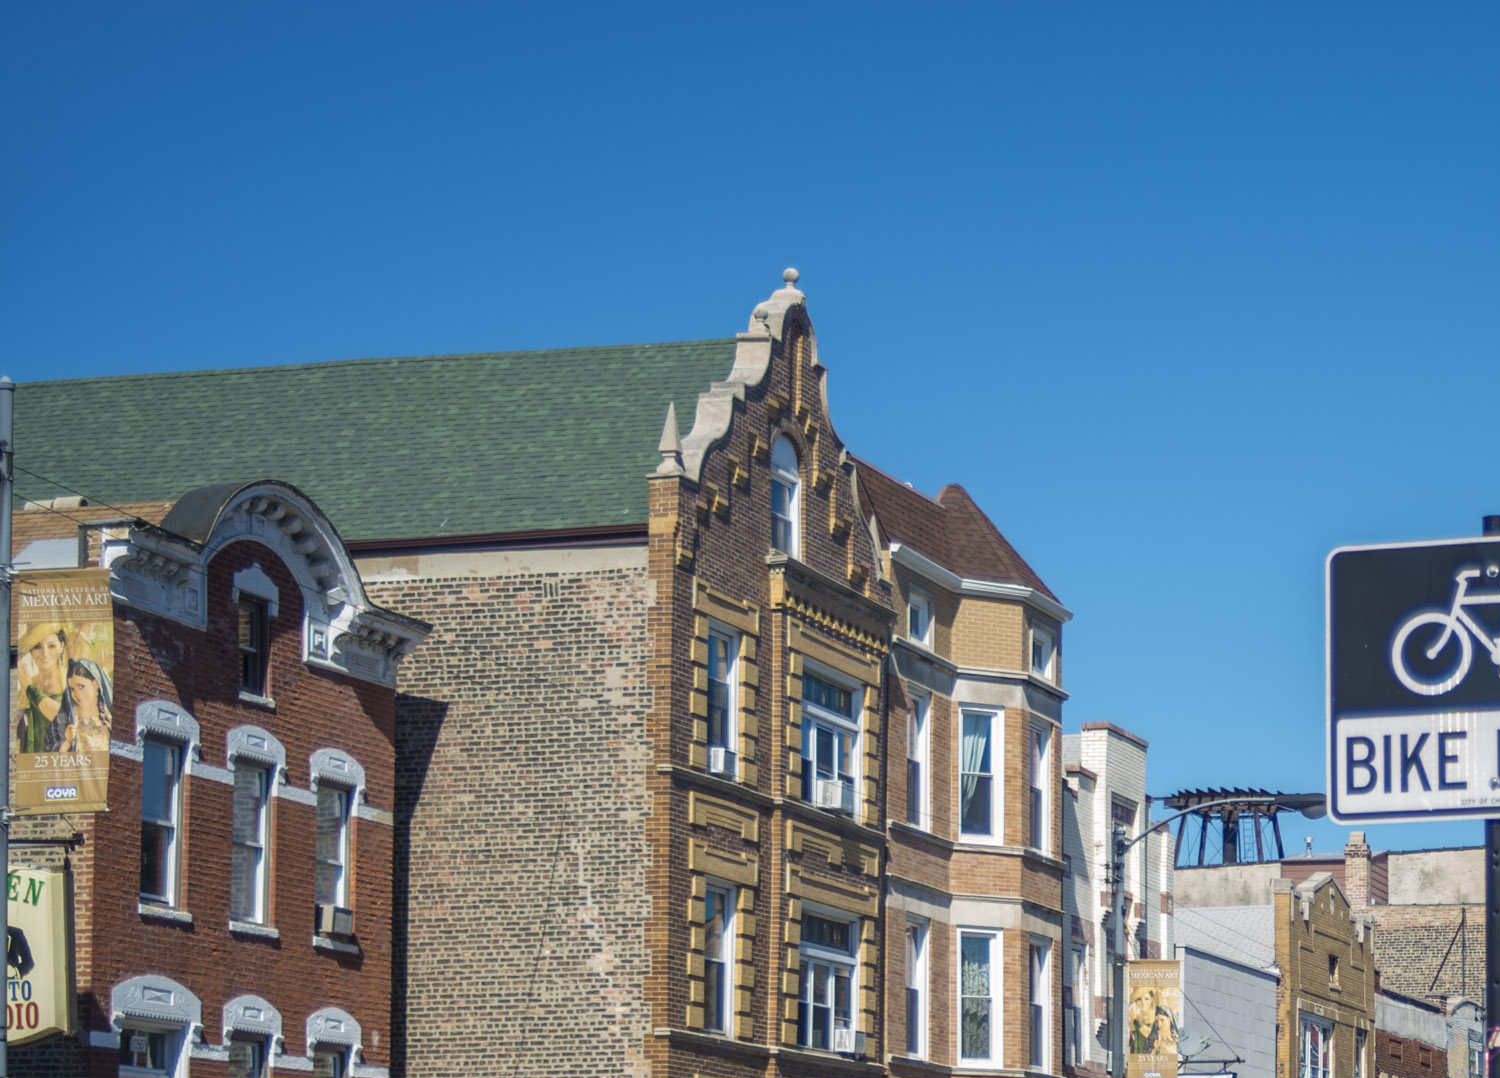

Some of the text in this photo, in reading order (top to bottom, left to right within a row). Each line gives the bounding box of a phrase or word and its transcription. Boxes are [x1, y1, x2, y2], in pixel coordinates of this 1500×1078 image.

[22, 592, 110, 607] MEXICAN ART
[34, 754, 92, 768] 25 YEARS
[1346, 730, 1468, 795] BIKE
[47, 788, 77, 799] GOYA
